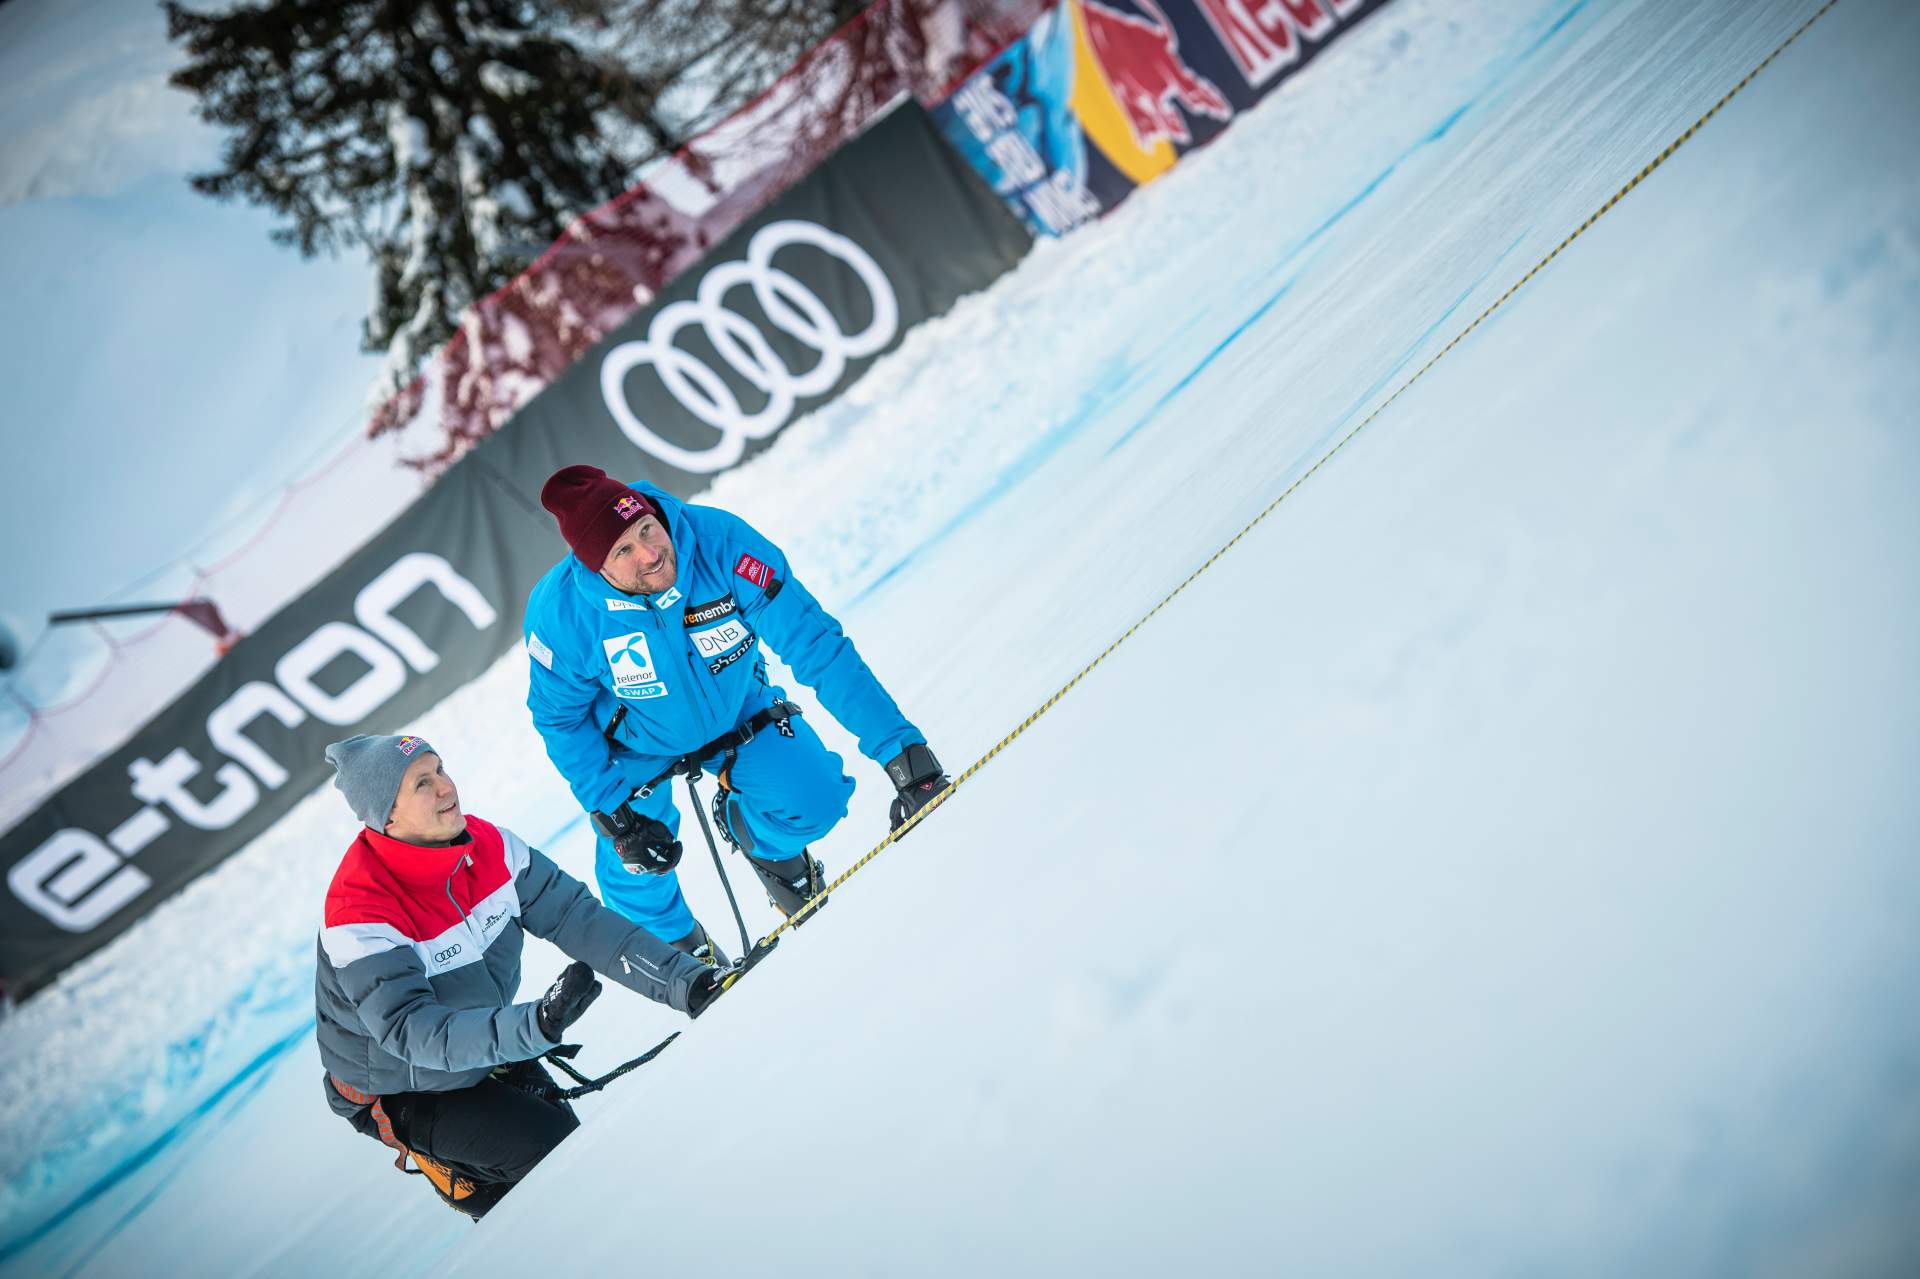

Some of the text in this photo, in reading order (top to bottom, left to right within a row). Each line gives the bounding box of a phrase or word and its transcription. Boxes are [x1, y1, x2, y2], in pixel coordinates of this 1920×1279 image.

[700, 627, 739, 651] DNB
[711, 635, 754, 674] phenix
[617, 671, 653, 684] telenor
[623, 687, 656, 696] SWAP
[7, 552, 497, 933] e-tron
